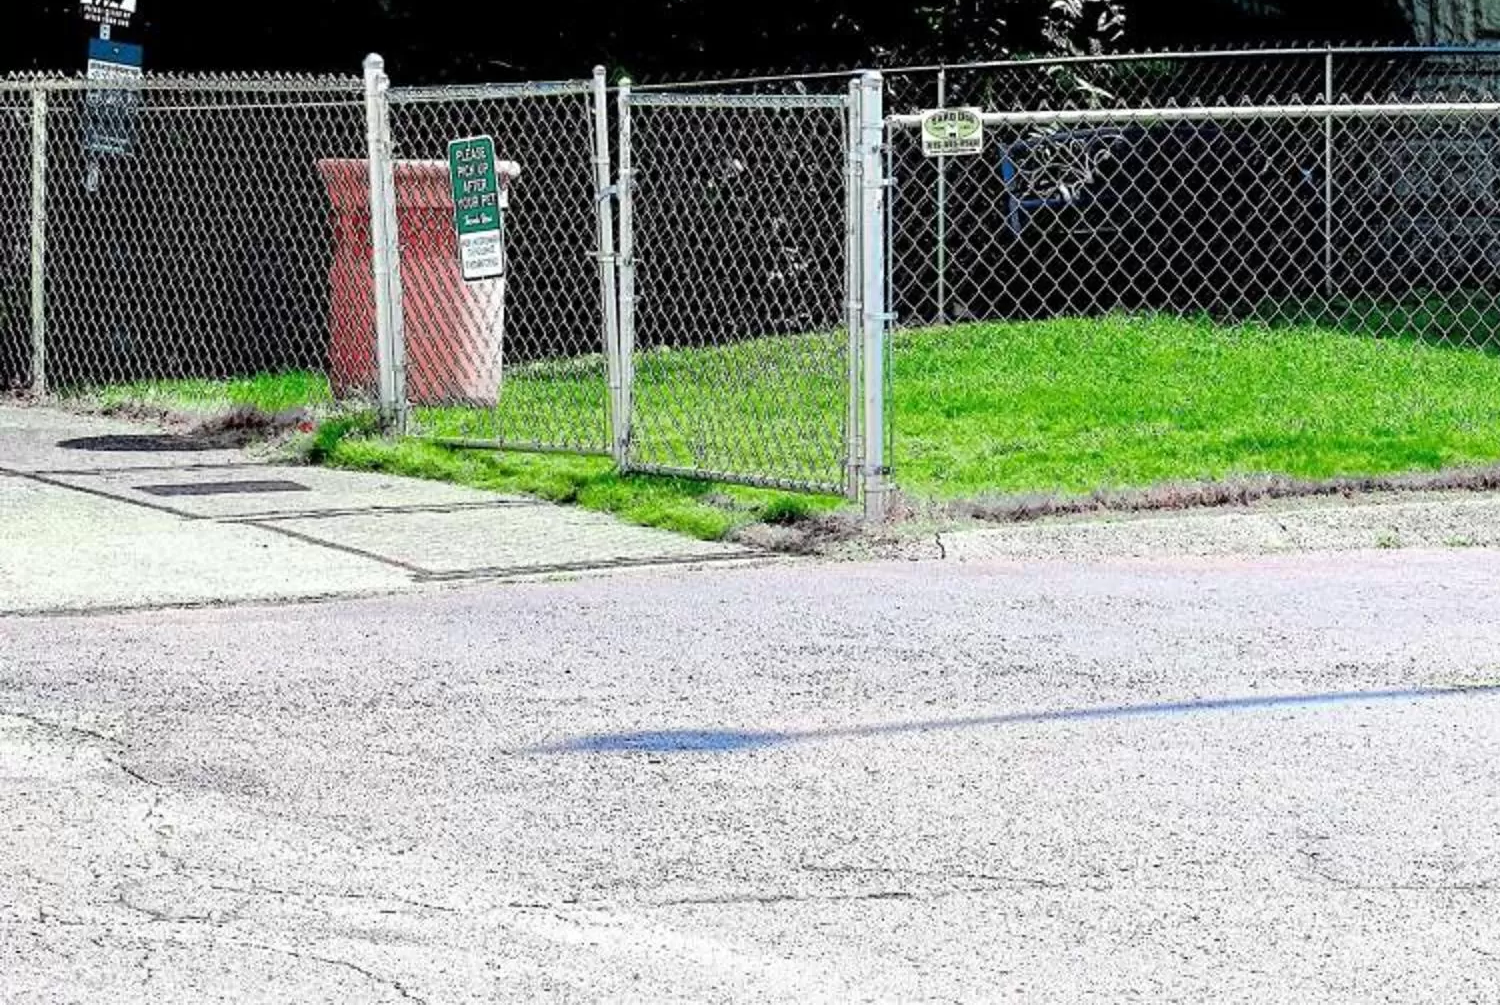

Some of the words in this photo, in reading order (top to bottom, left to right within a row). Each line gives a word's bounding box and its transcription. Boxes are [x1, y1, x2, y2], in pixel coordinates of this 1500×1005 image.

[456, 147, 486, 161] PLEASE
[457, 164, 474, 178] PICK
[464, 179, 486, 193] AFTER
[458, 196, 478, 209] YOUR
[482, 193, 497, 207] PET
